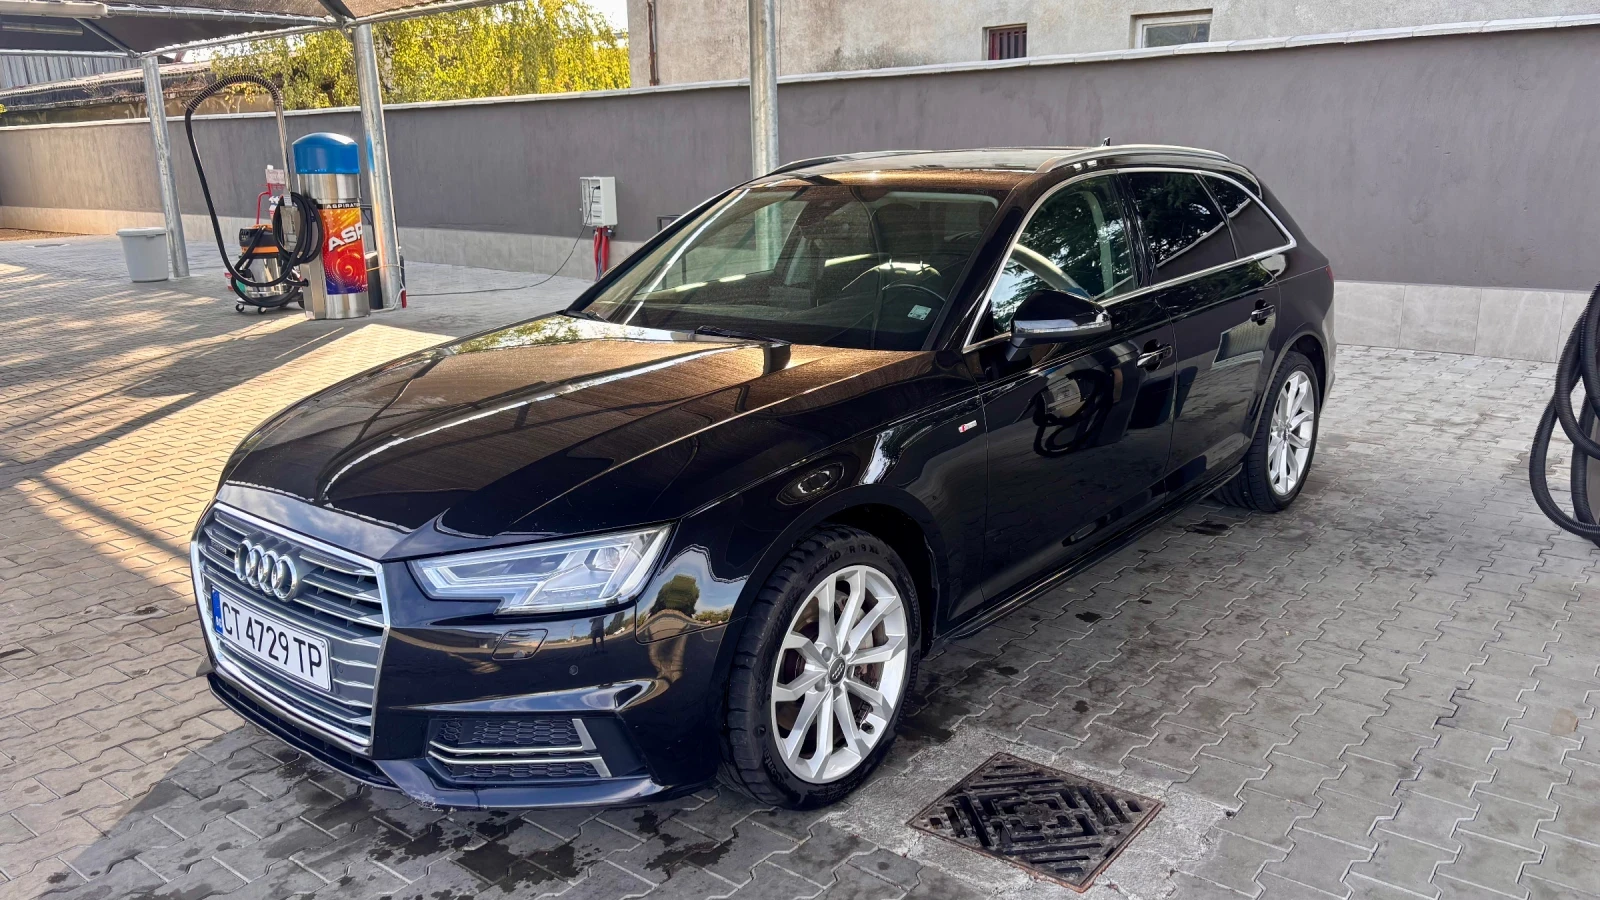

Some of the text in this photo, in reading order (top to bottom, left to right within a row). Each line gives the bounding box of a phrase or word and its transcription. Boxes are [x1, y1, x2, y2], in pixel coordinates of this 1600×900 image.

[222, 601, 322, 677] CT 4729 TP
